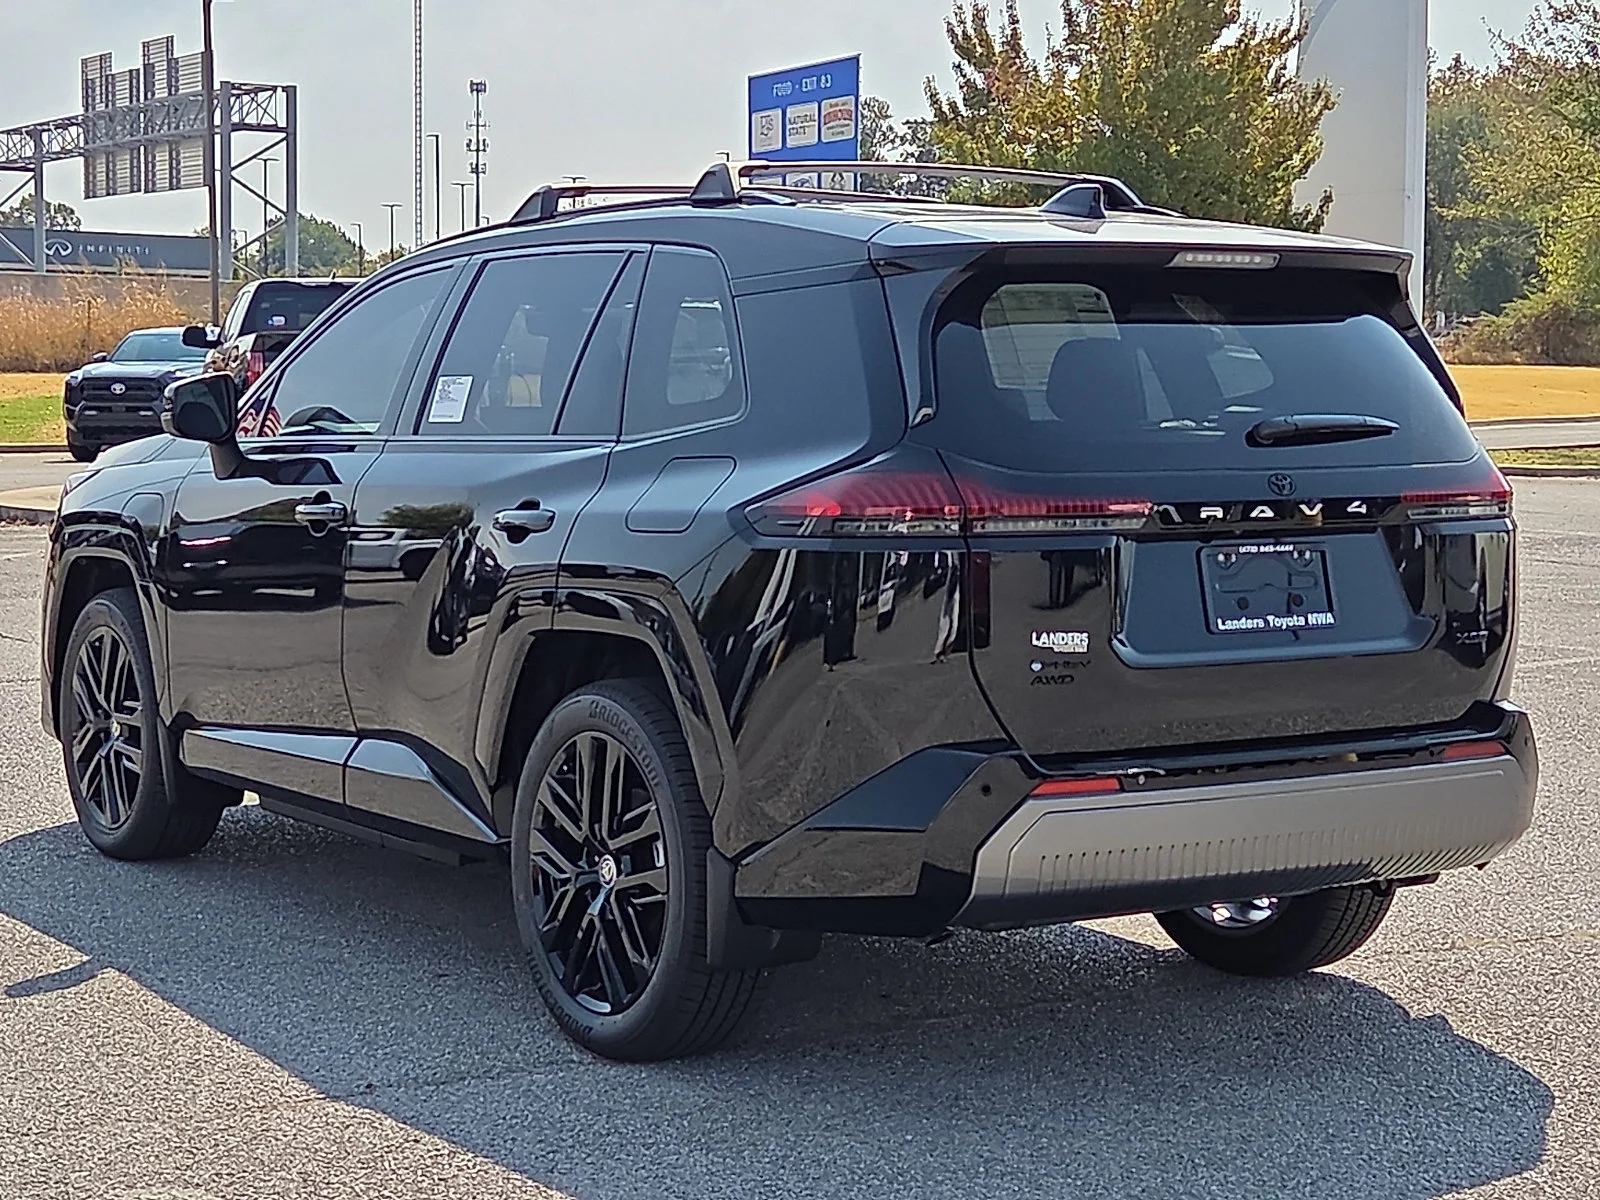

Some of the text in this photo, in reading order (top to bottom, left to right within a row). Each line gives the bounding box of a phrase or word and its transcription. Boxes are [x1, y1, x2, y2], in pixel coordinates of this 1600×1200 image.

[821, 74, 831, 88] 83
[78, 243, 151, 256] INFINITI
[1217, 612, 1335, 631] Landers Toyota NWA
[1031, 631, 1089, 647] LANDERS
[588, 699, 660, 788] BRIDGESTONE
